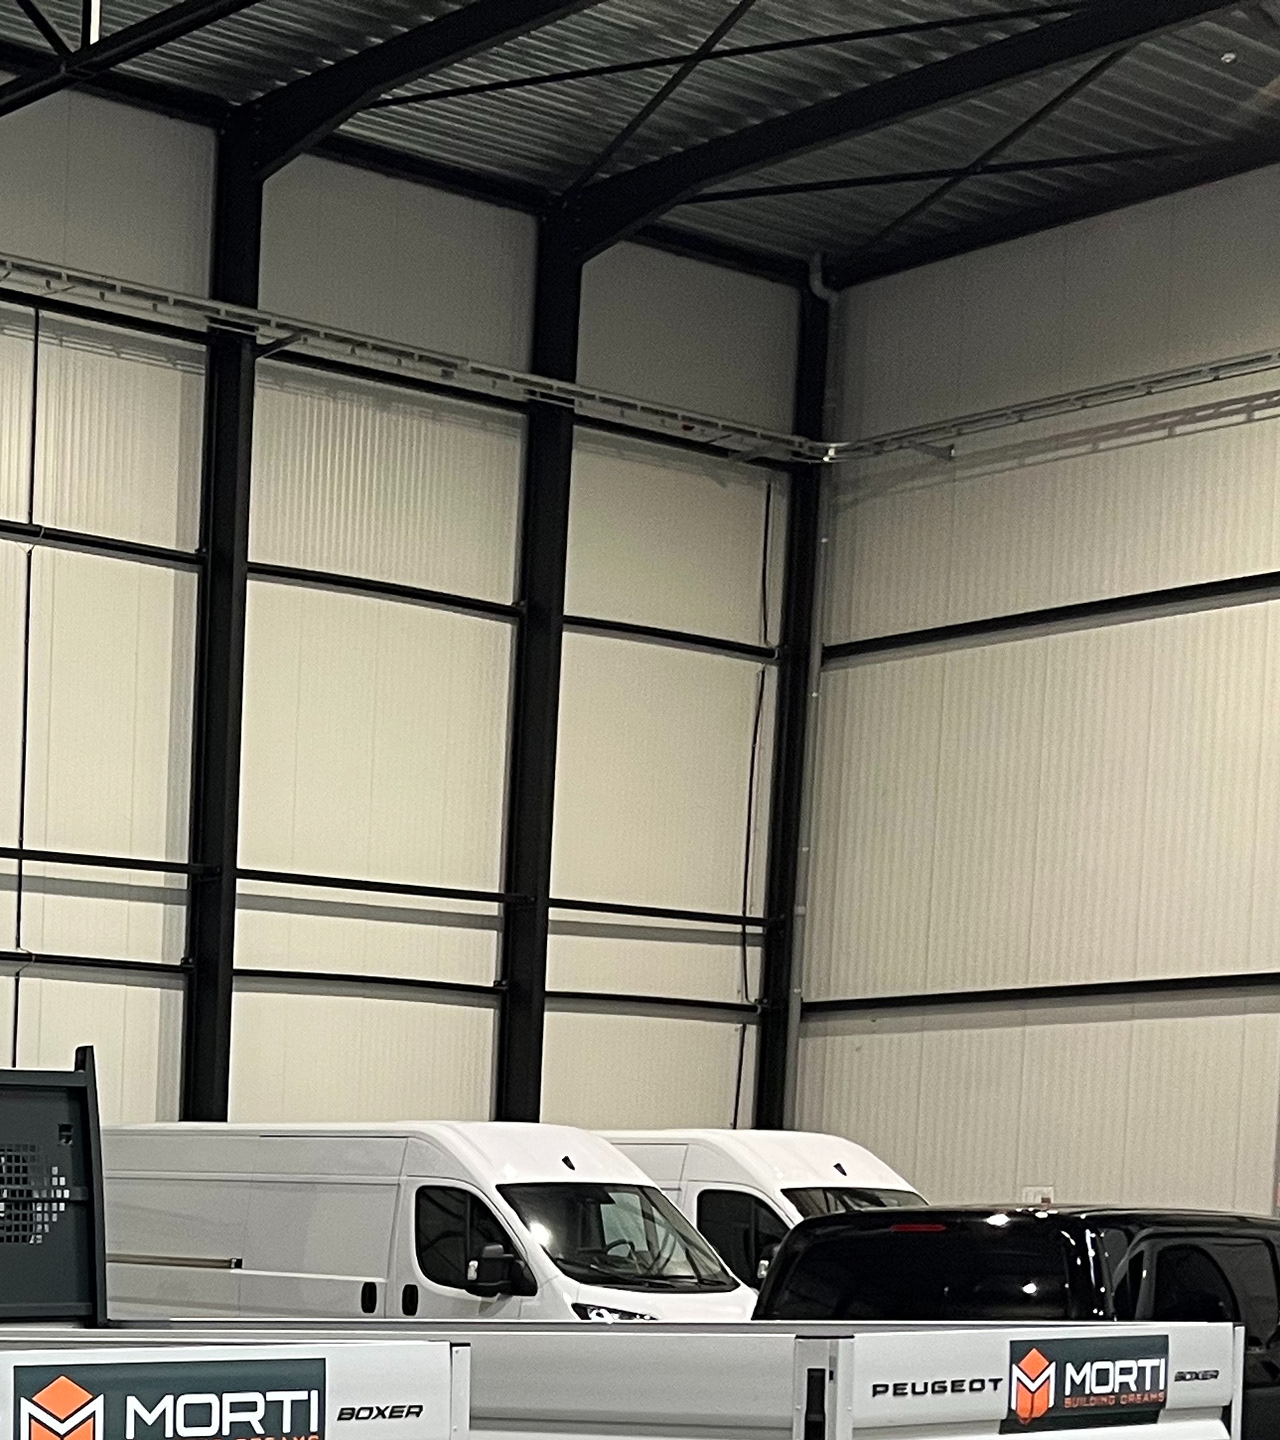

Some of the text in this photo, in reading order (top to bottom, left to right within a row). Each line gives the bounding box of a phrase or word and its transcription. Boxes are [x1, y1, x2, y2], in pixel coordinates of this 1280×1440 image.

[872, 1378, 1003, 1397] PEUGEOT
[1064, 1358, 1166, 1396] MORTI
[125, 1389, 319, 1439] MORTI
[336, 1404, 424, 1421] BOXER
